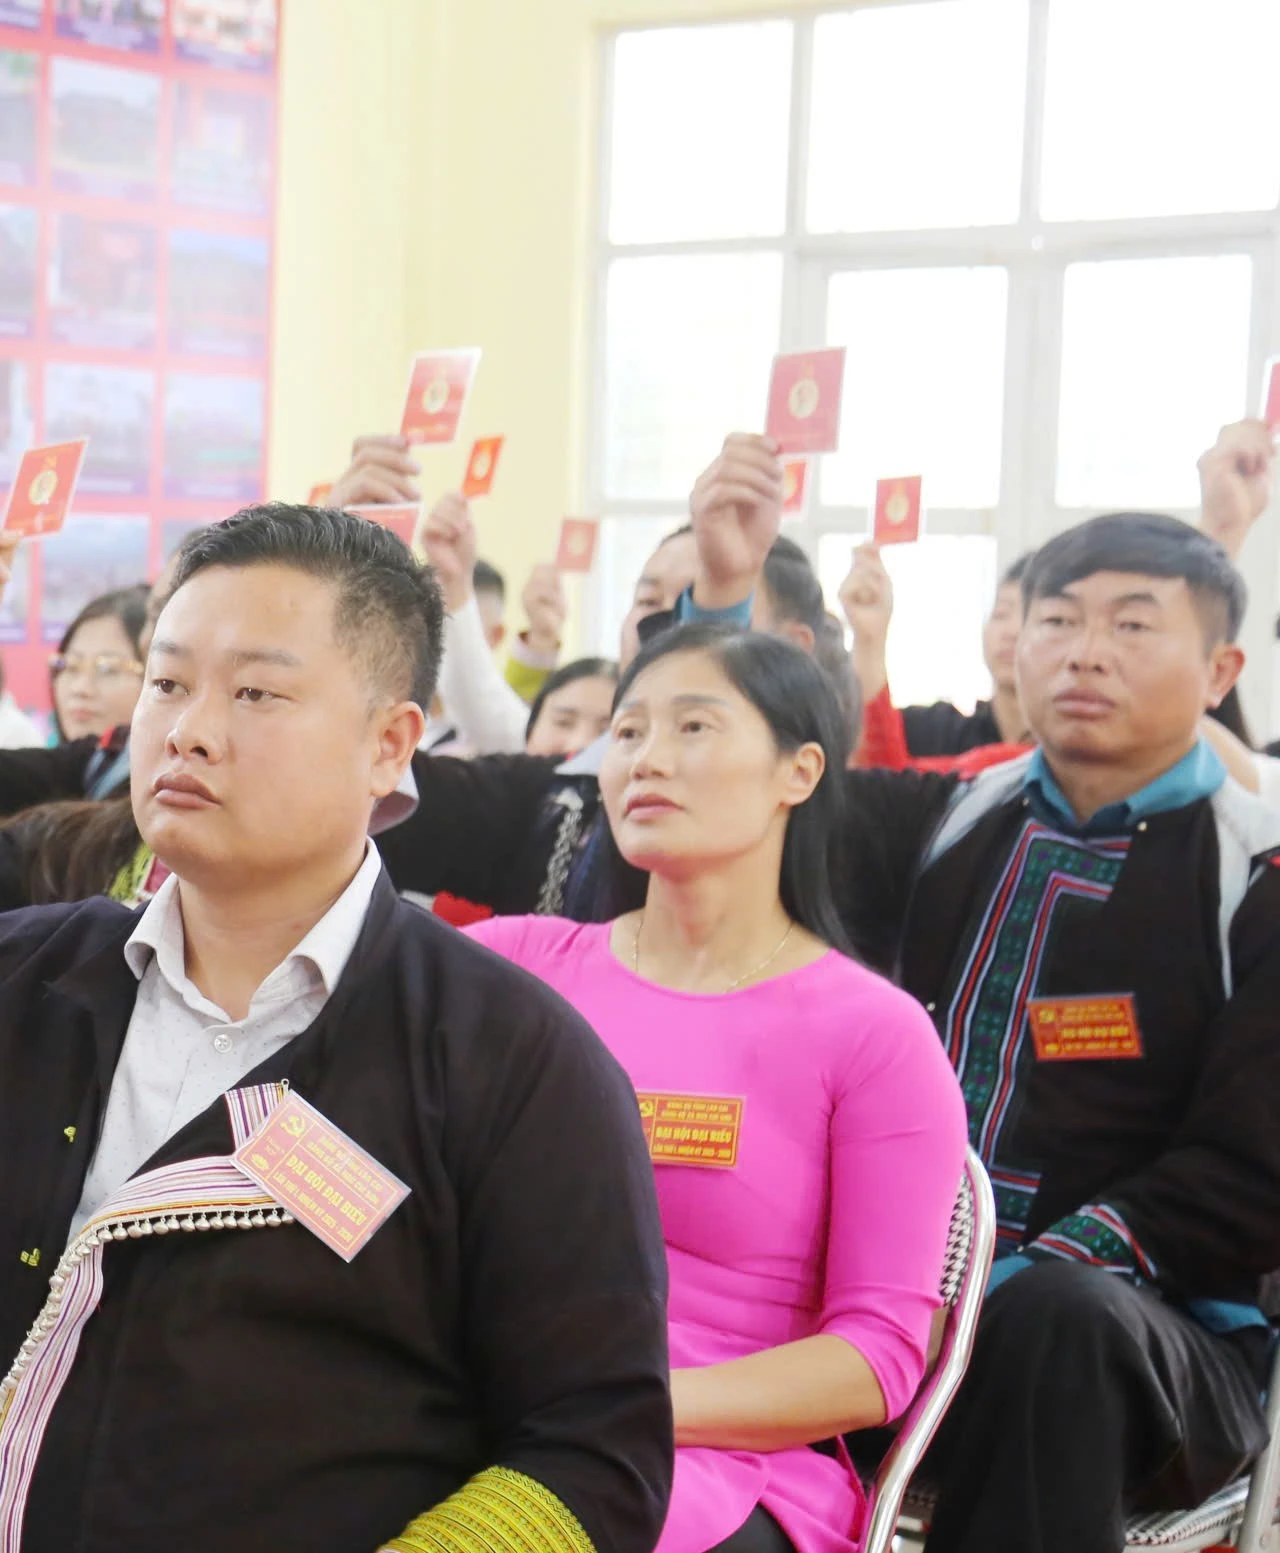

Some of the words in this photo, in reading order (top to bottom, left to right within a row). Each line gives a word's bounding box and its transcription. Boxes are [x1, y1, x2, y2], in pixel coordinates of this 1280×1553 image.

[286, 1154, 305, 1176] ĐẠI
[304, 1169, 325, 1192] HỘI
[322, 1185, 343, 1207] ĐẠI
[341, 1199, 366, 1226] BIỂU
